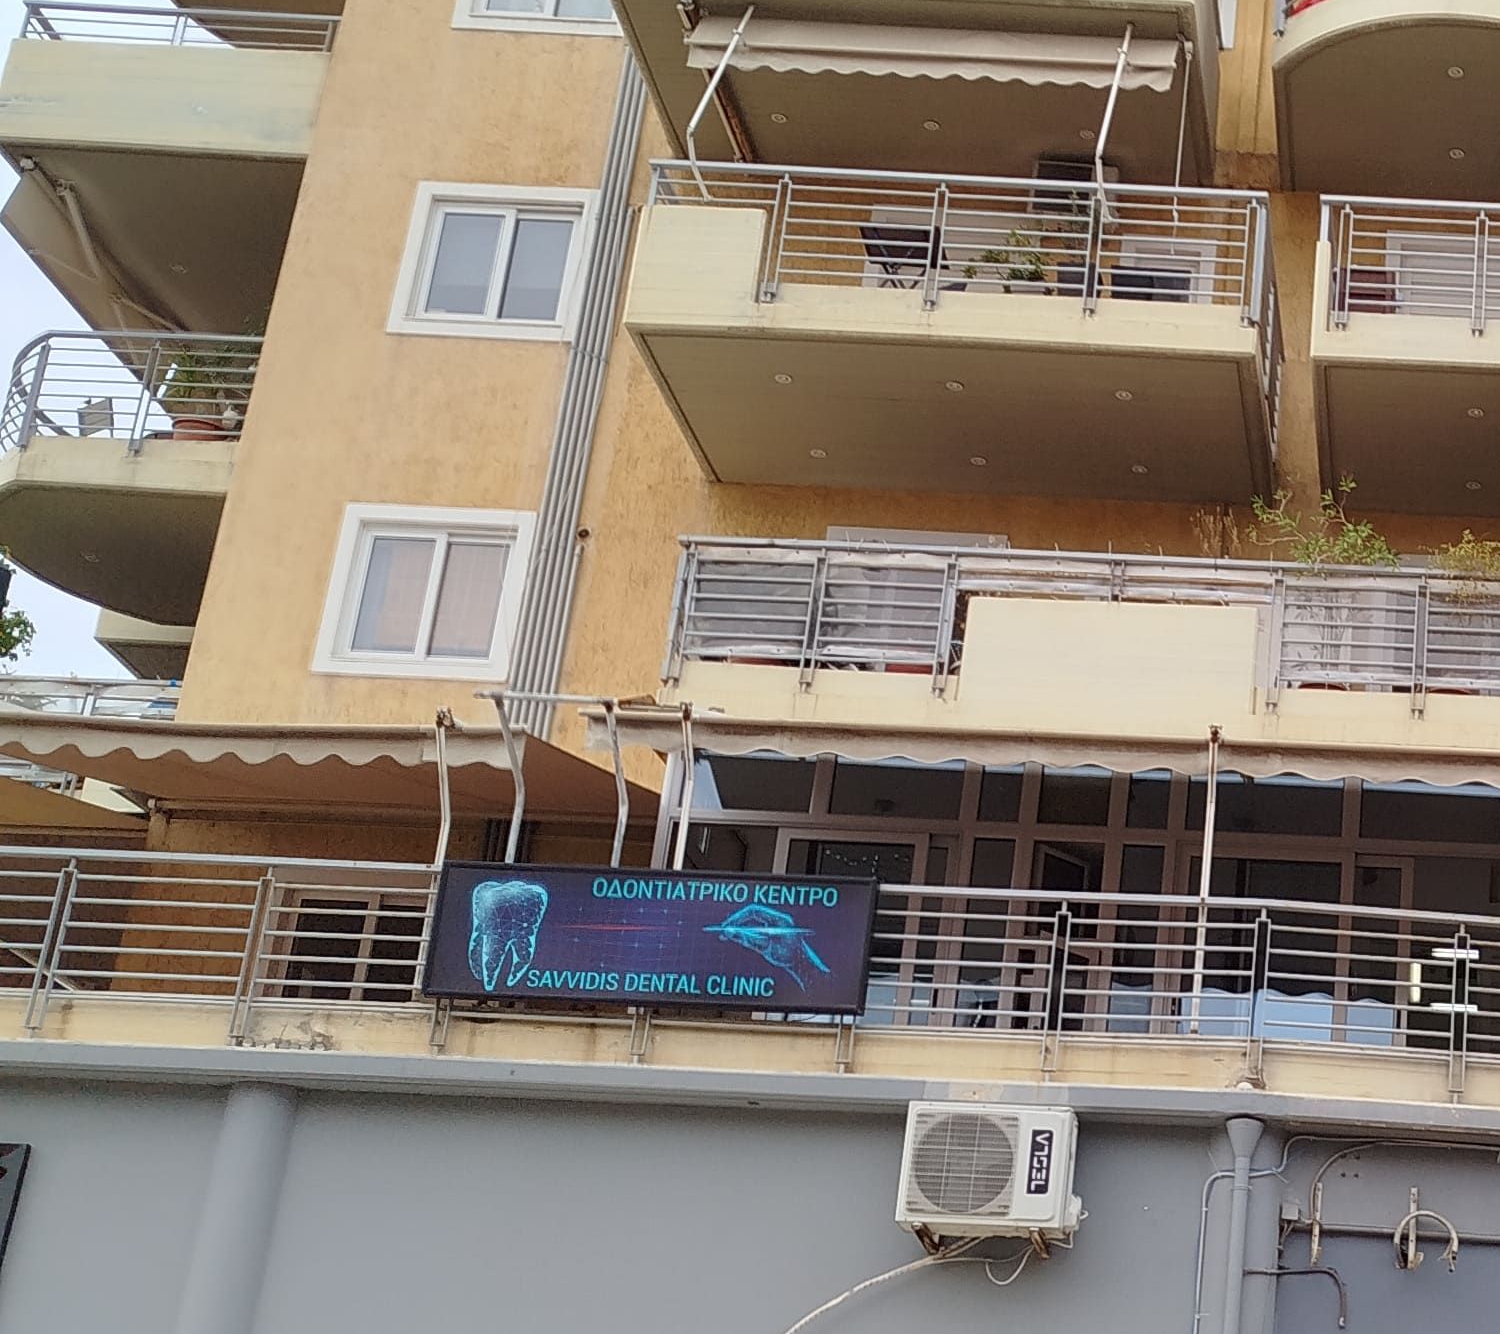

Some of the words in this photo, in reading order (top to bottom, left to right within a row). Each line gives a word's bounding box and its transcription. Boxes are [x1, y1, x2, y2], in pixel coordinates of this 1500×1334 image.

[593, 878, 748, 903] ΟΔΟΝΤΙΑΤΡΙΚΟ
[753, 885, 838, 907] ΚΕΝΤΡΟ
[527, 970, 619, 992] SAVVIDIS
[624, 973, 701, 995] DENTAL
[706, 975, 775, 997] CLINIC
[1031, 1132, 1050, 1192] TESLA
